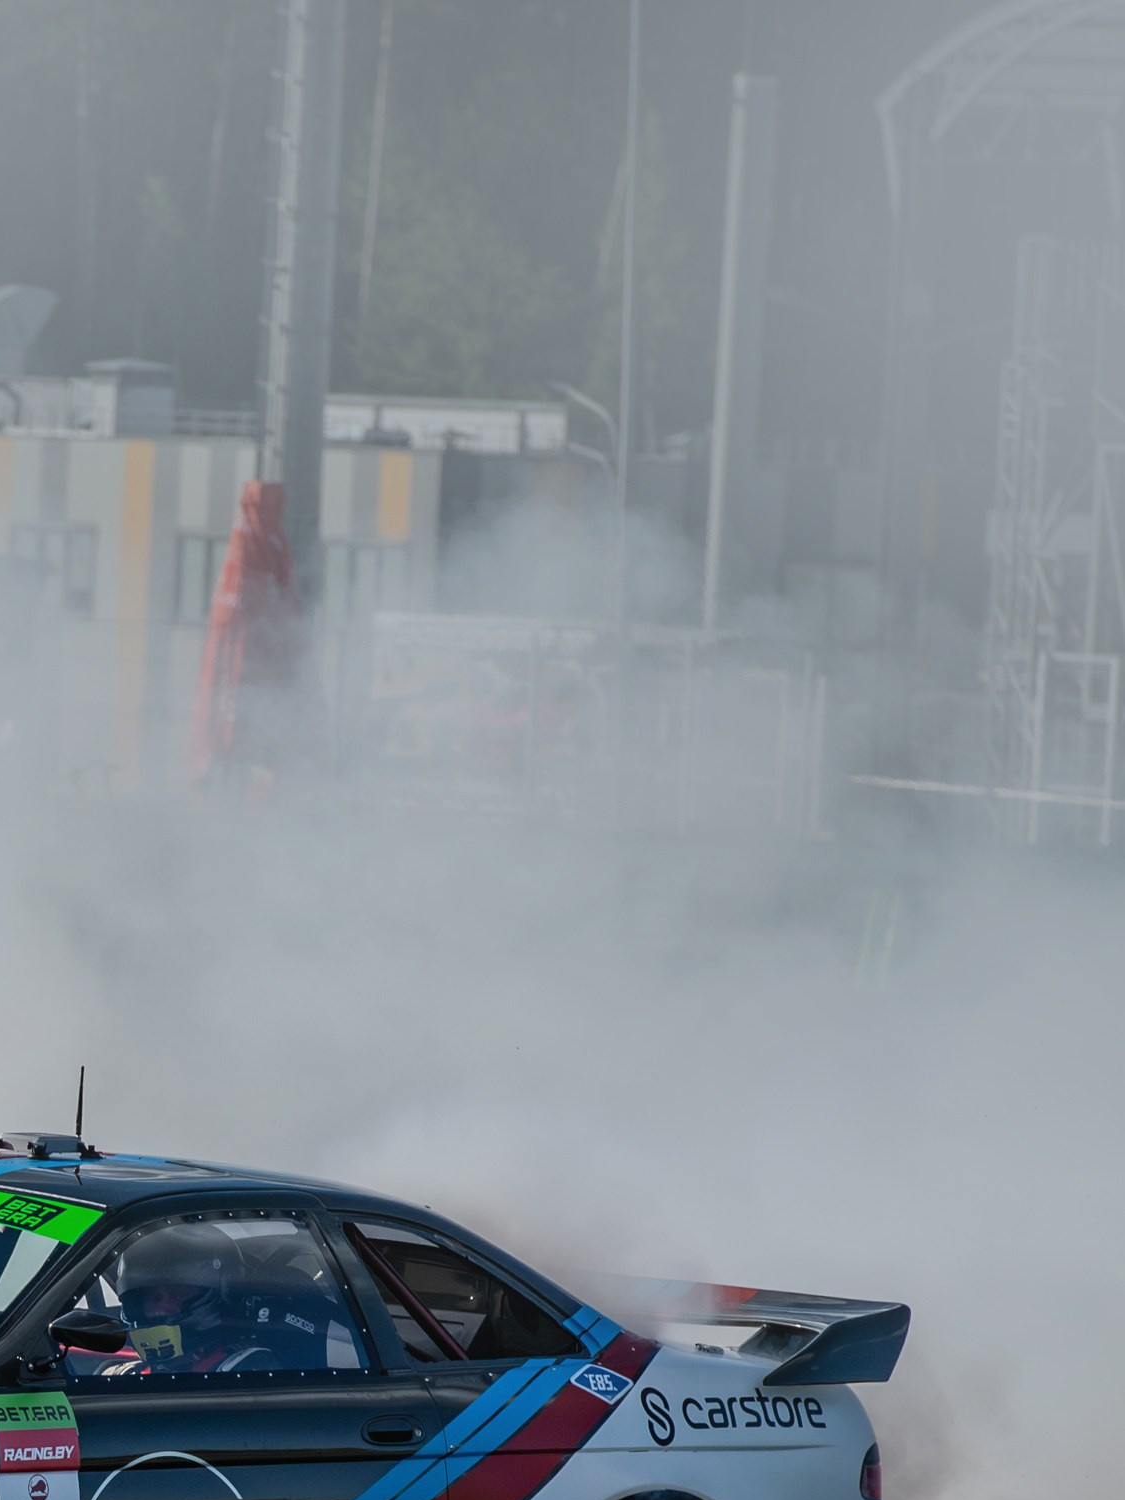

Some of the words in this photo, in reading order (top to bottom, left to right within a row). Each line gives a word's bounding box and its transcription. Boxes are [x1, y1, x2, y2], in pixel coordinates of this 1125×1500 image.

[4, 1199, 57, 1217] BET
[682, 1388, 827, 1429] carstore
[3, 1445, 75, 1462] RACING.BY
